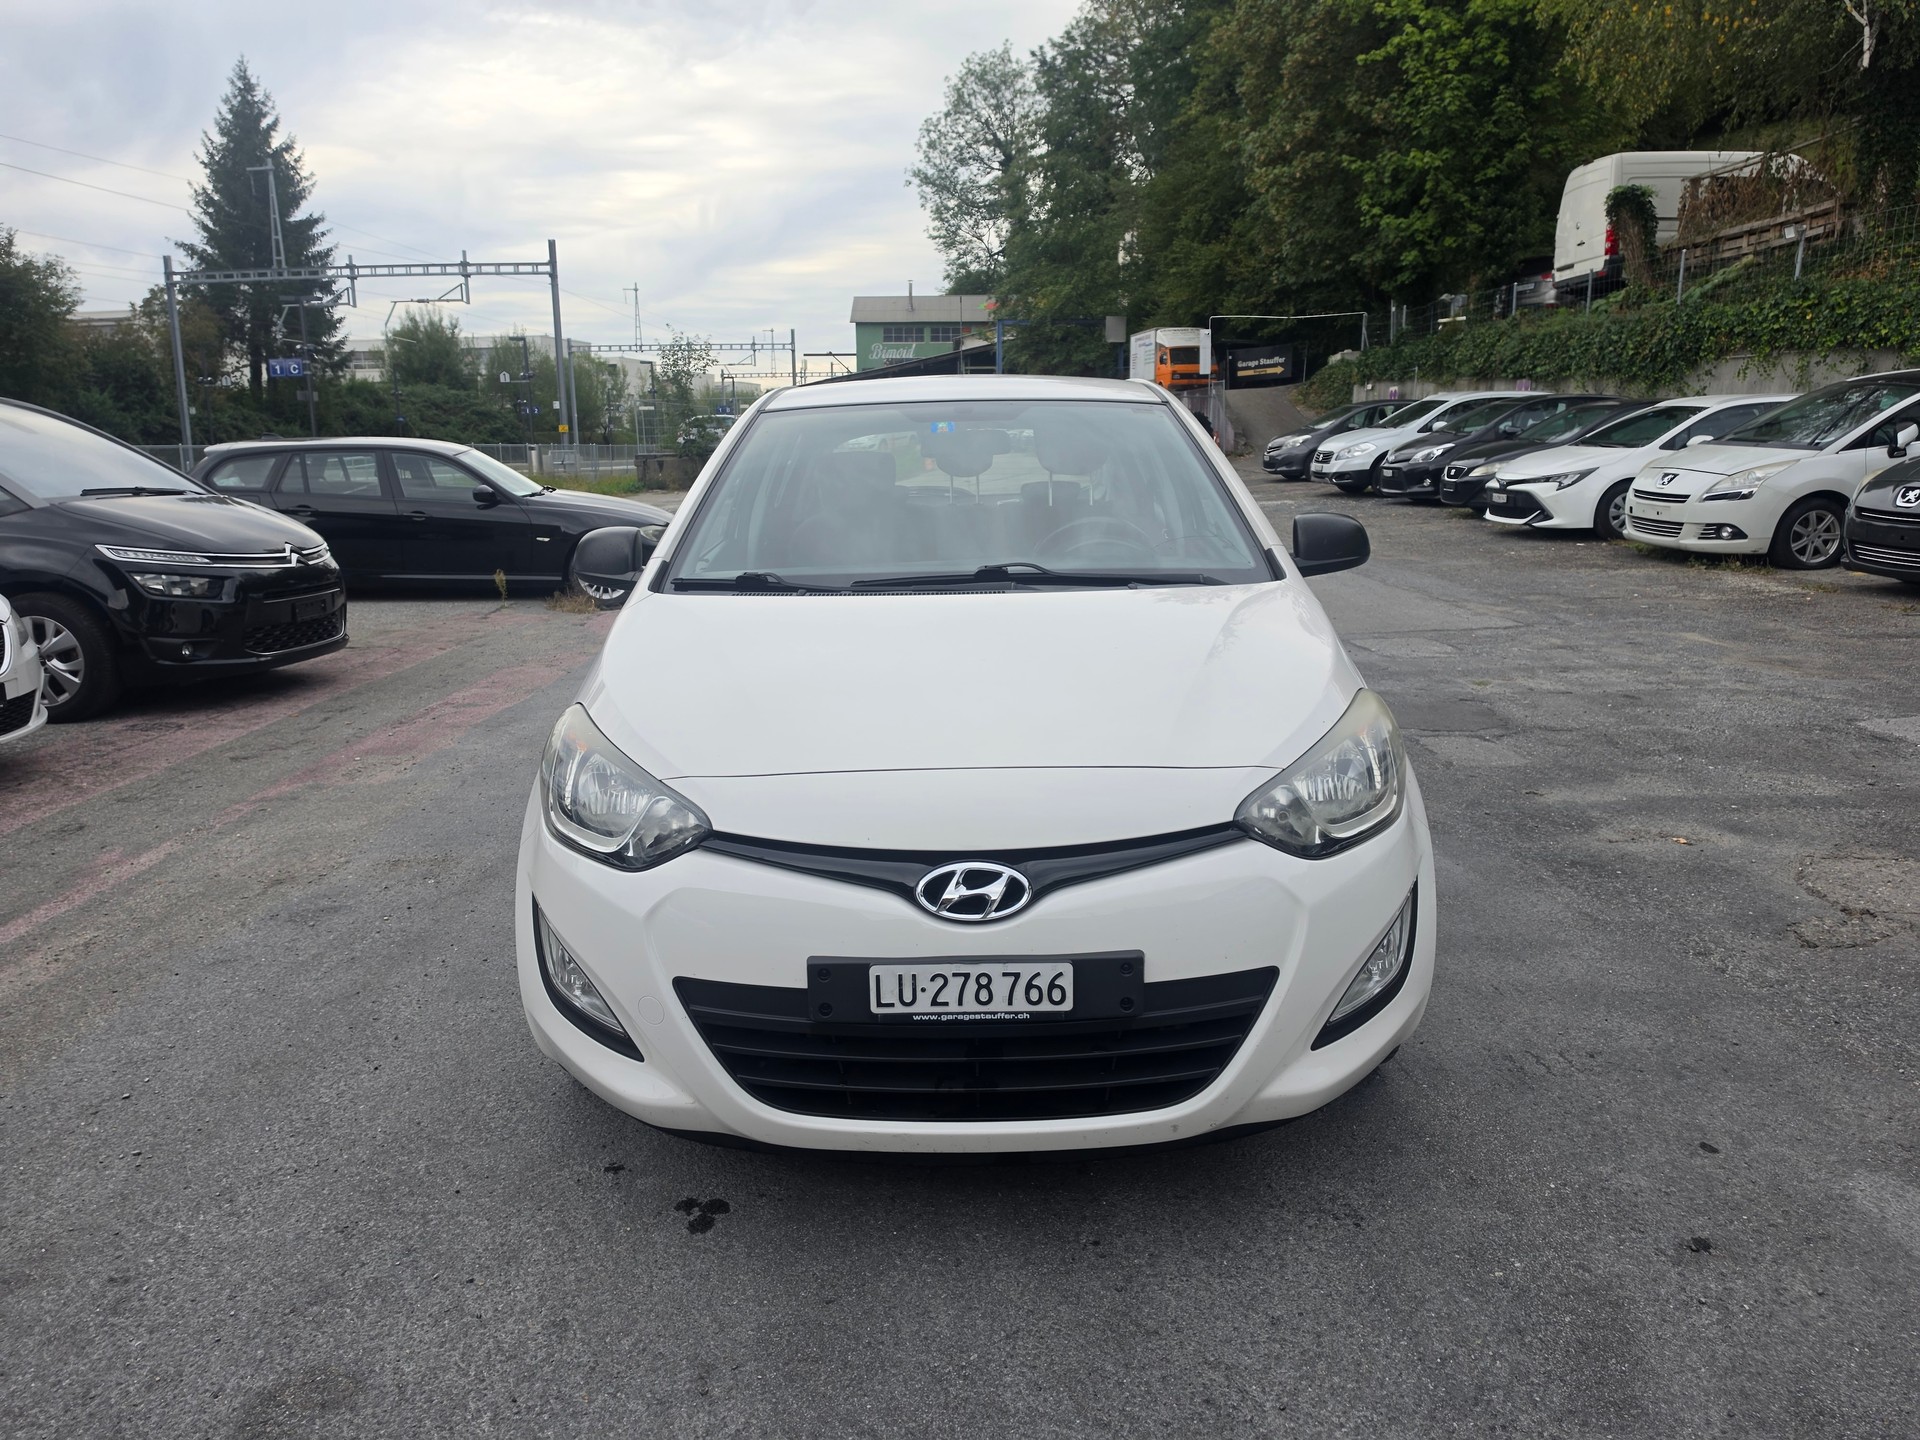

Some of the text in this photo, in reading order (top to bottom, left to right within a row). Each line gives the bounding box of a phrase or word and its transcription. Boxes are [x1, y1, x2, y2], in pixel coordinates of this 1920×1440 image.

[868, 343, 916, 360] Bimoid
[1237, 356, 1286, 368] Garage Stauffer
[274, 364, 299, 375] 1 C
[912, 1012, 1031, 1021] www.garagestauffer.ch
